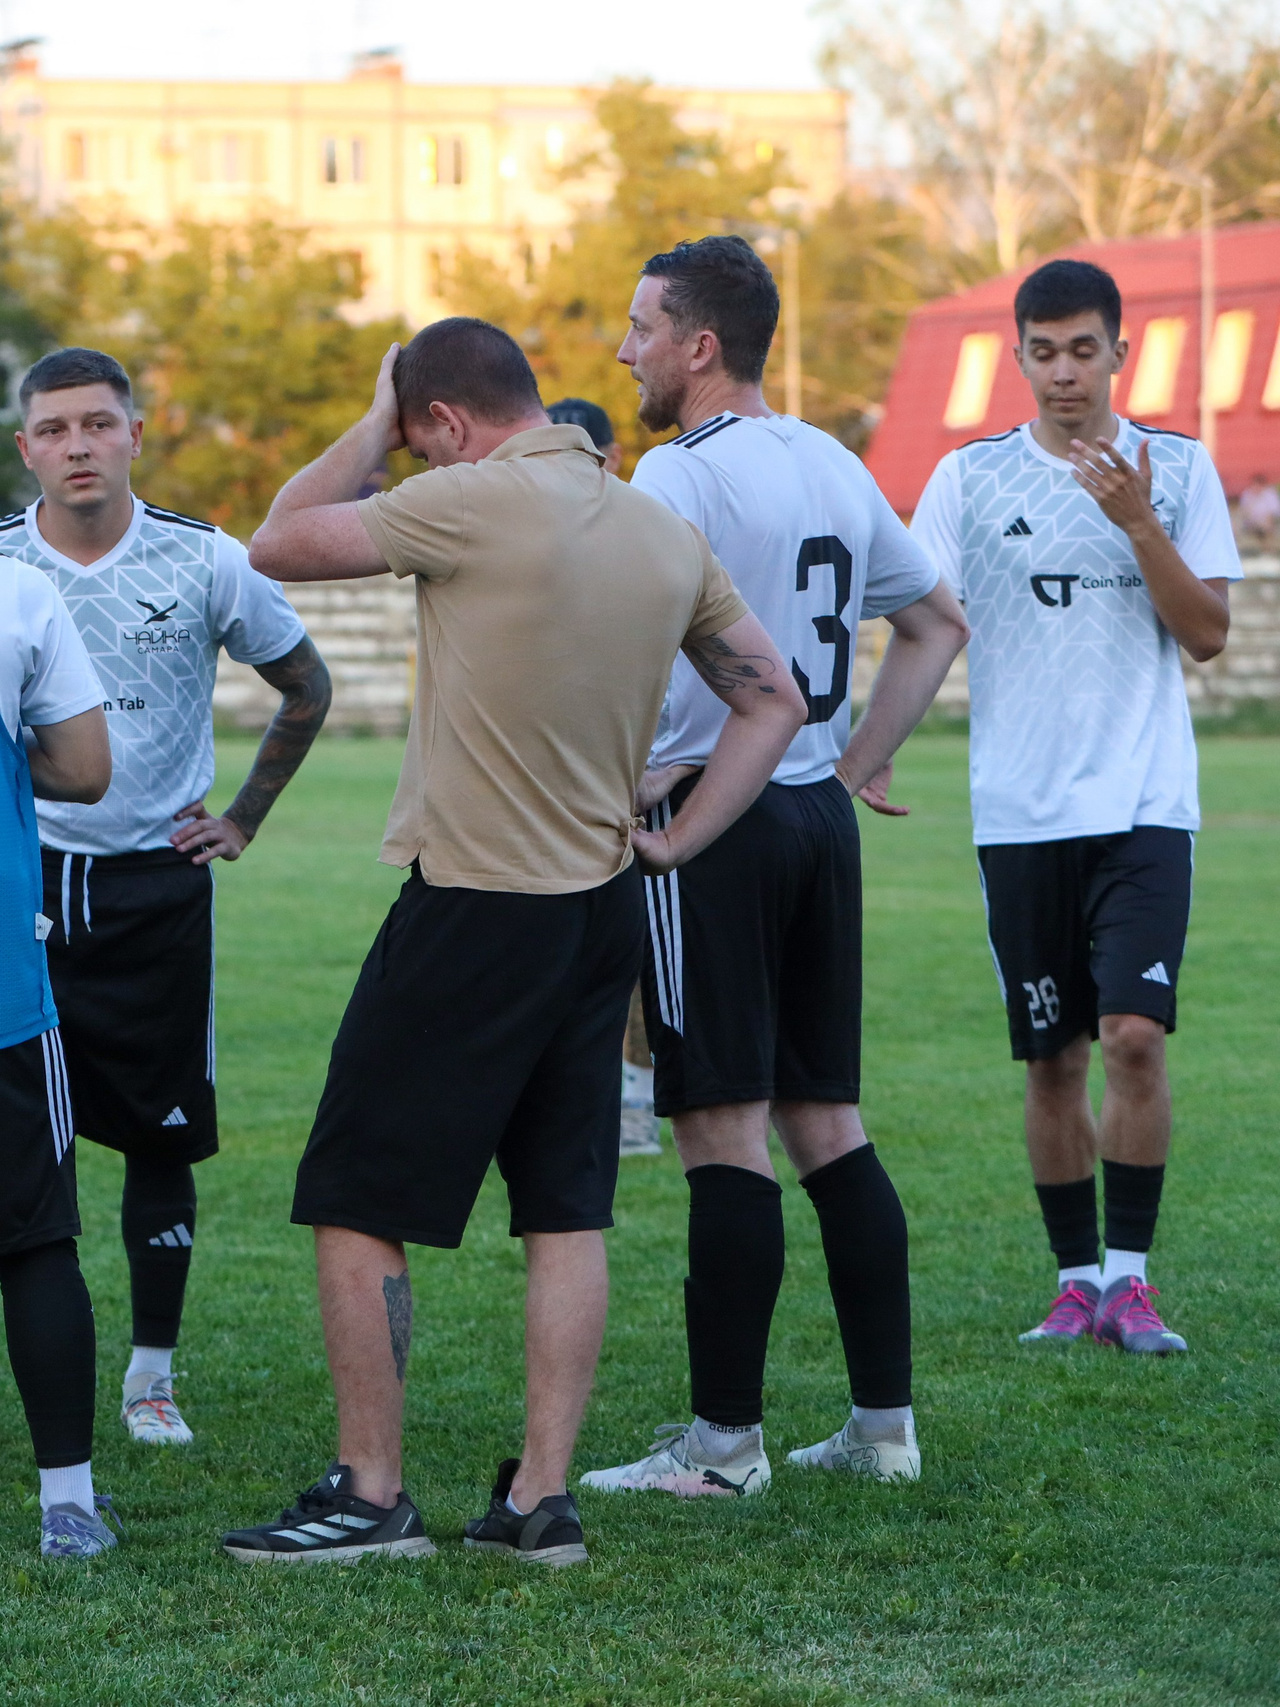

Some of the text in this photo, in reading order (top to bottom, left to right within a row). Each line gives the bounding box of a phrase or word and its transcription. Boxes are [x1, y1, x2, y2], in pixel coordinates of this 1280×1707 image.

[1081, 575, 1114, 589] Coin
[1118, 574, 1142, 588] Tab
[123, 627, 191, 645] ЧАЙКА
[791, 535, 853, 726] 3
[137, 645, 180, 655] САМАРА
[117, 696, 146, 711] Tab
[1021, 974, 1060, 1029] 28
